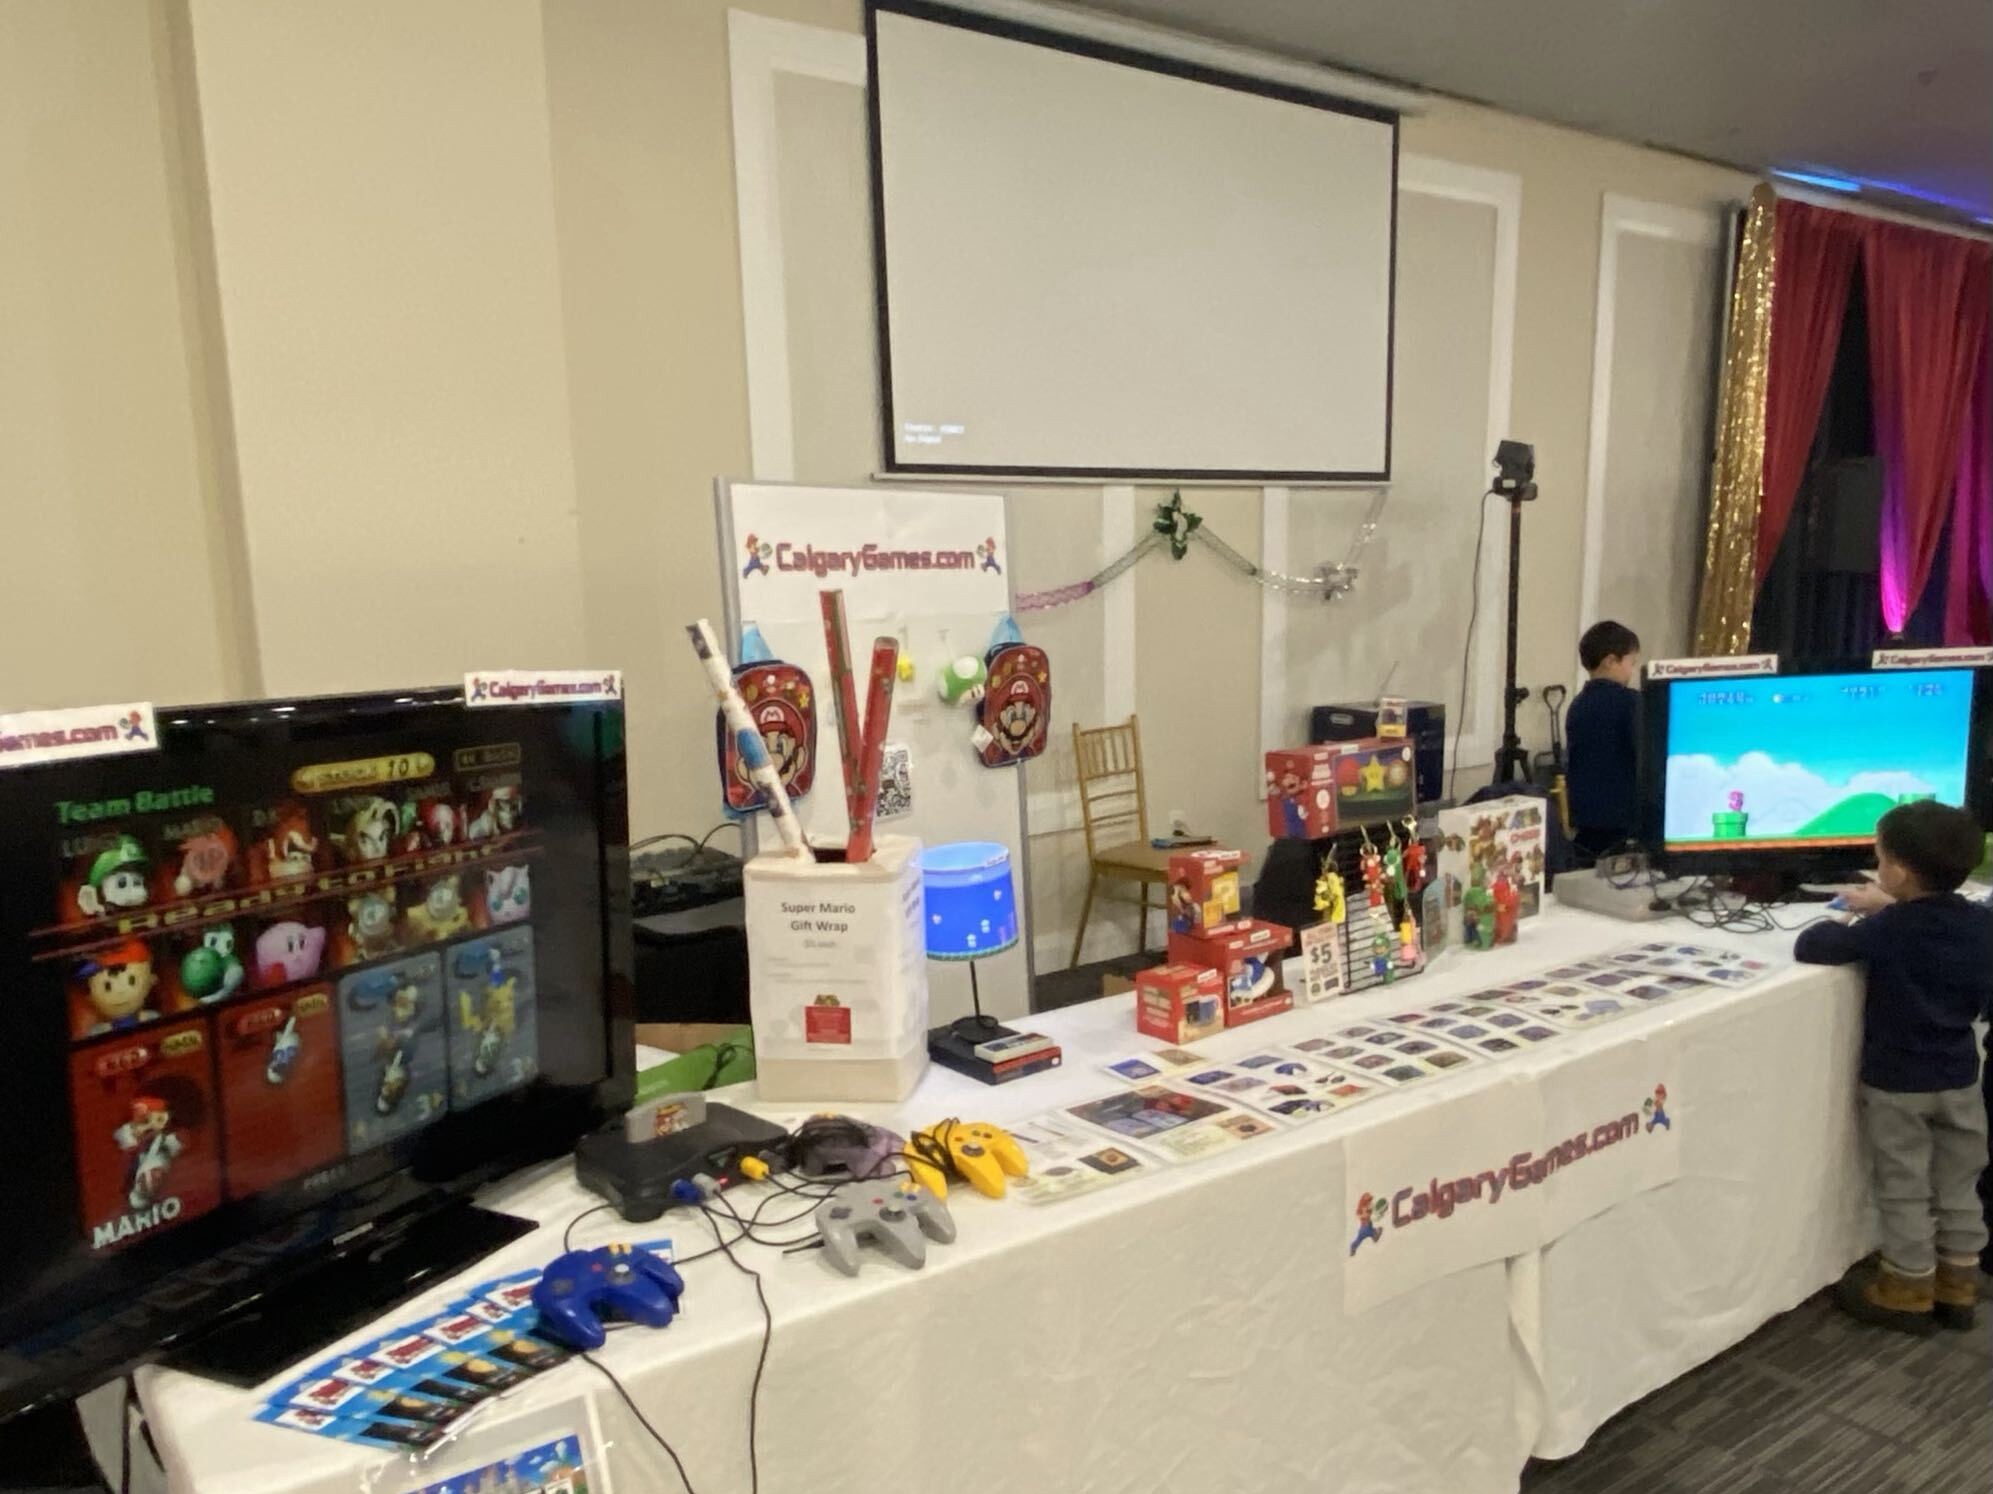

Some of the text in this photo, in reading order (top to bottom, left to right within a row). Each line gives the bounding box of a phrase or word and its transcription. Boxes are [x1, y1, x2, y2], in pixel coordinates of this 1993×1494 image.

[775, 542, 975, 577] CalgaryGames.com
[489, 679, 602, 701] CalgaryGames.com
[0, 725, 118, 752] ames.com
[388, 757, 410, 777] 10
[57, 785, 214, 824] Team Battle
[781, 901, 856, 914] Super Mario
[790, 920, 848, 933] Gift Wrap
[1310, 942, 1332, 964] $5
[1391, 1112, 1640, 1228] CalgaryGames.com
[92, 1197, 182, 1250] MARIO
